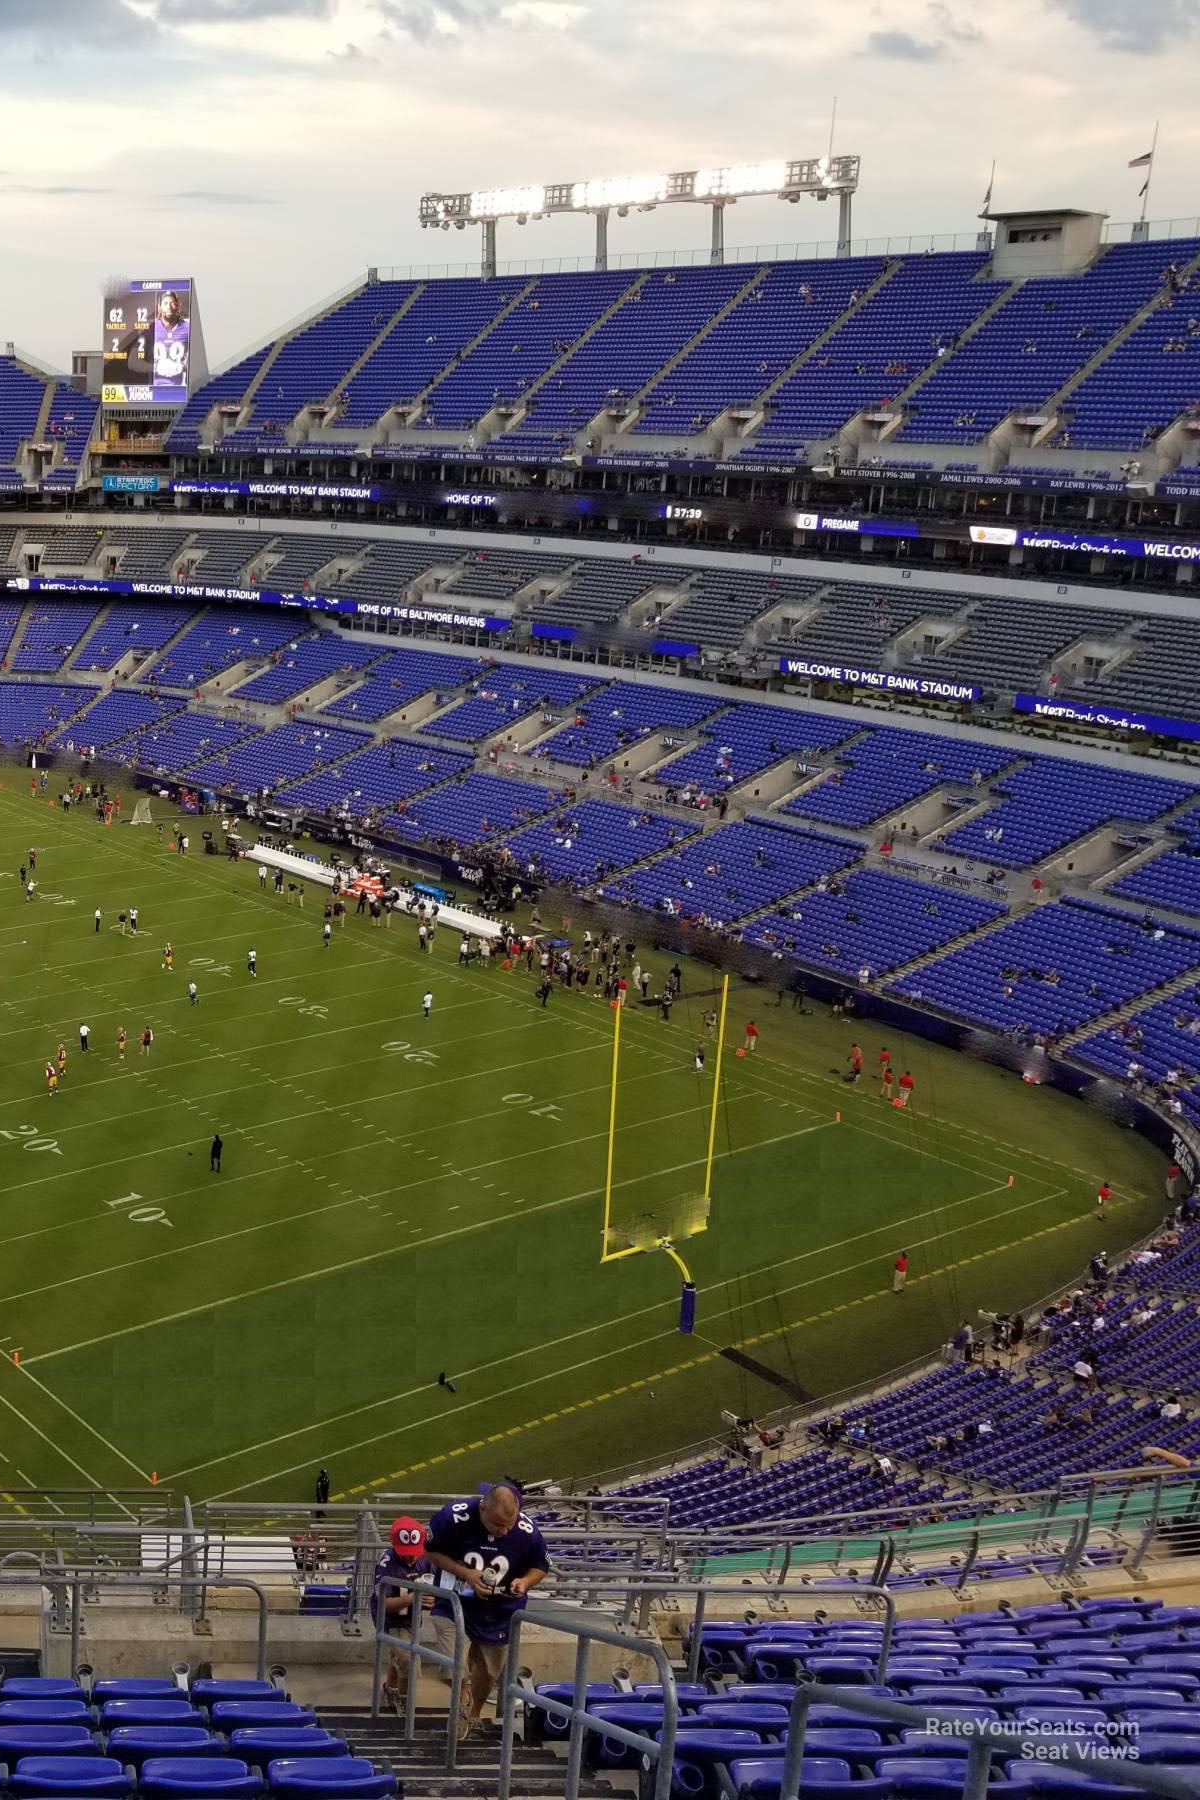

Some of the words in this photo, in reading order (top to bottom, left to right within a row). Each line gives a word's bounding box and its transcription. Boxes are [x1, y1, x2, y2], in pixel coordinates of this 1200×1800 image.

[110, 308, 123, 322] 62
[112, 338, 119, 352] 2
[138, 338, 145, 352] 2
[104, 387, 117, 400] 99
[715, 463, 744, 472] JONATHAN
[840, 469, 857, 477] MATT
[857, 470, 881, 478] STOVER
[117, 477, 156, 485] STRATEGIC
[940, 475, 962, 483] JAMAL
[963, 476, 983, 484] LEWIS
[1050, 480, 1063, 488] RAY
[1064, 480, 1085, 489] LEWIS
[1086, 482, 1124, 491] 1996-2012
[249, 484, 287, 494] WELCOME
[288, 485, 300, 494] TO
[300, 486, 318, 495] M&T
[318, 487, 339, 496] BANK
[339, 488, 371, 498] STADIUM
[1166, 486, 1188, 495] TODD
[673, 507, 702, 519] 37:39
[822, 519, 860, 530] PREGAME
[132, 583, 173, 594] WELCOME
[174, 584, 185, 595] TO
[186, 585, 204, 596] M&T
[205, 588, 226, 598] BANK
[227, 589, 260, 601] STADIUM
[358, 603, 380, 616] HOME
[381, 605, 392, 616] OF
[393, 607, 408, 619] THE
[409, 608, 453, 623] BALTIMORE
[453, 614, 486, 628] RAVENS
[787, 660, 841, 680] WELCOME
[843, 668, 860, 681] TO
[861, 671, 886, 686] M&T
[887, 675, 919, 691] BANK
[920, 680, 973, 699] STADIUM
[101, 1191, 167, 1223] 10
[451, 1502, 471, 1524] 82
